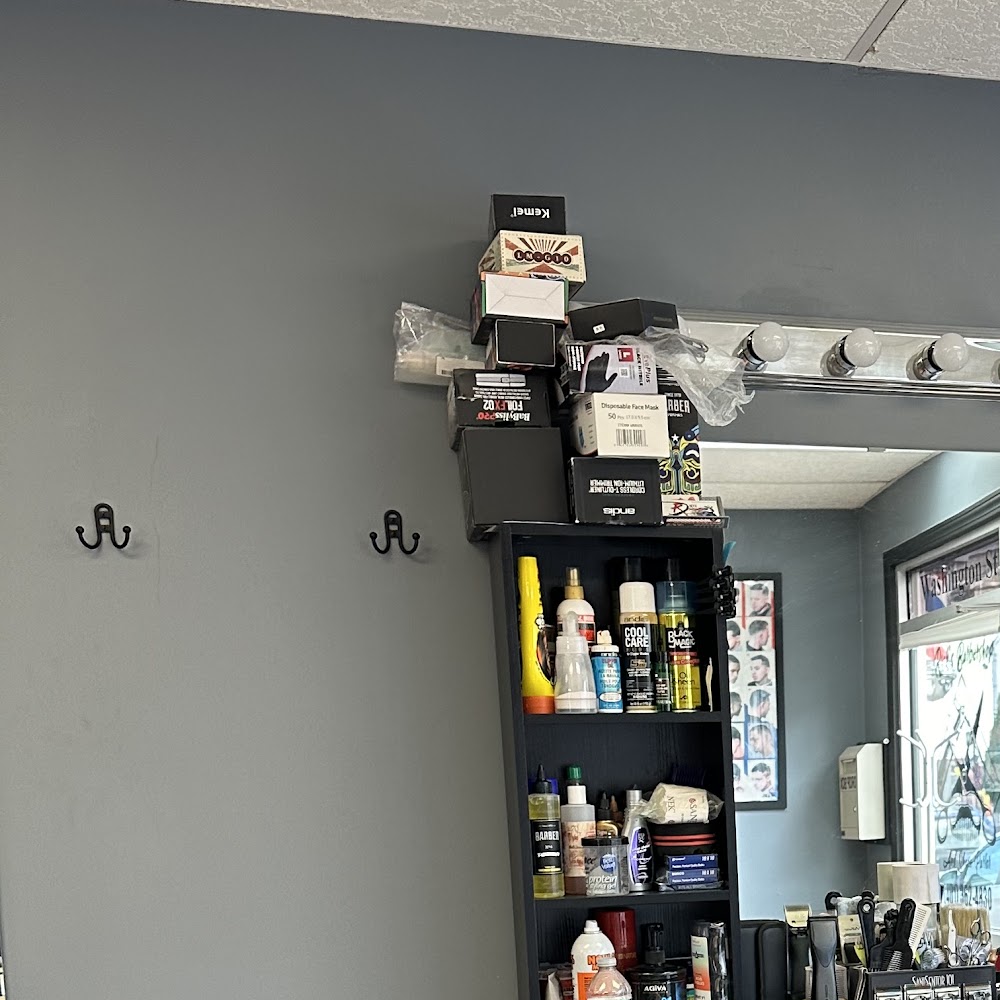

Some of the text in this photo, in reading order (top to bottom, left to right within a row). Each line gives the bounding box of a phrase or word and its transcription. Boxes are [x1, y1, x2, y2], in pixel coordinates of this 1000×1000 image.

[512, 206, 550, 219] Kemei
[601, 402, 631, 410] Disposable
[645, 403, 659, 411] Mask
[607, 412, 617, 420] 50
[602, 507, 636, 517] andis
[920, 560, 982, 598] Washington
[624, 627, 649, 638] COOL
[668, 629, 693, 644] BLACK
[625, 637, 650, 648] CARE
[673, 638, 696, 648] MAGIC
[534, 830, 560, 842] BARBER
[589, 873, 617, 884] protein
